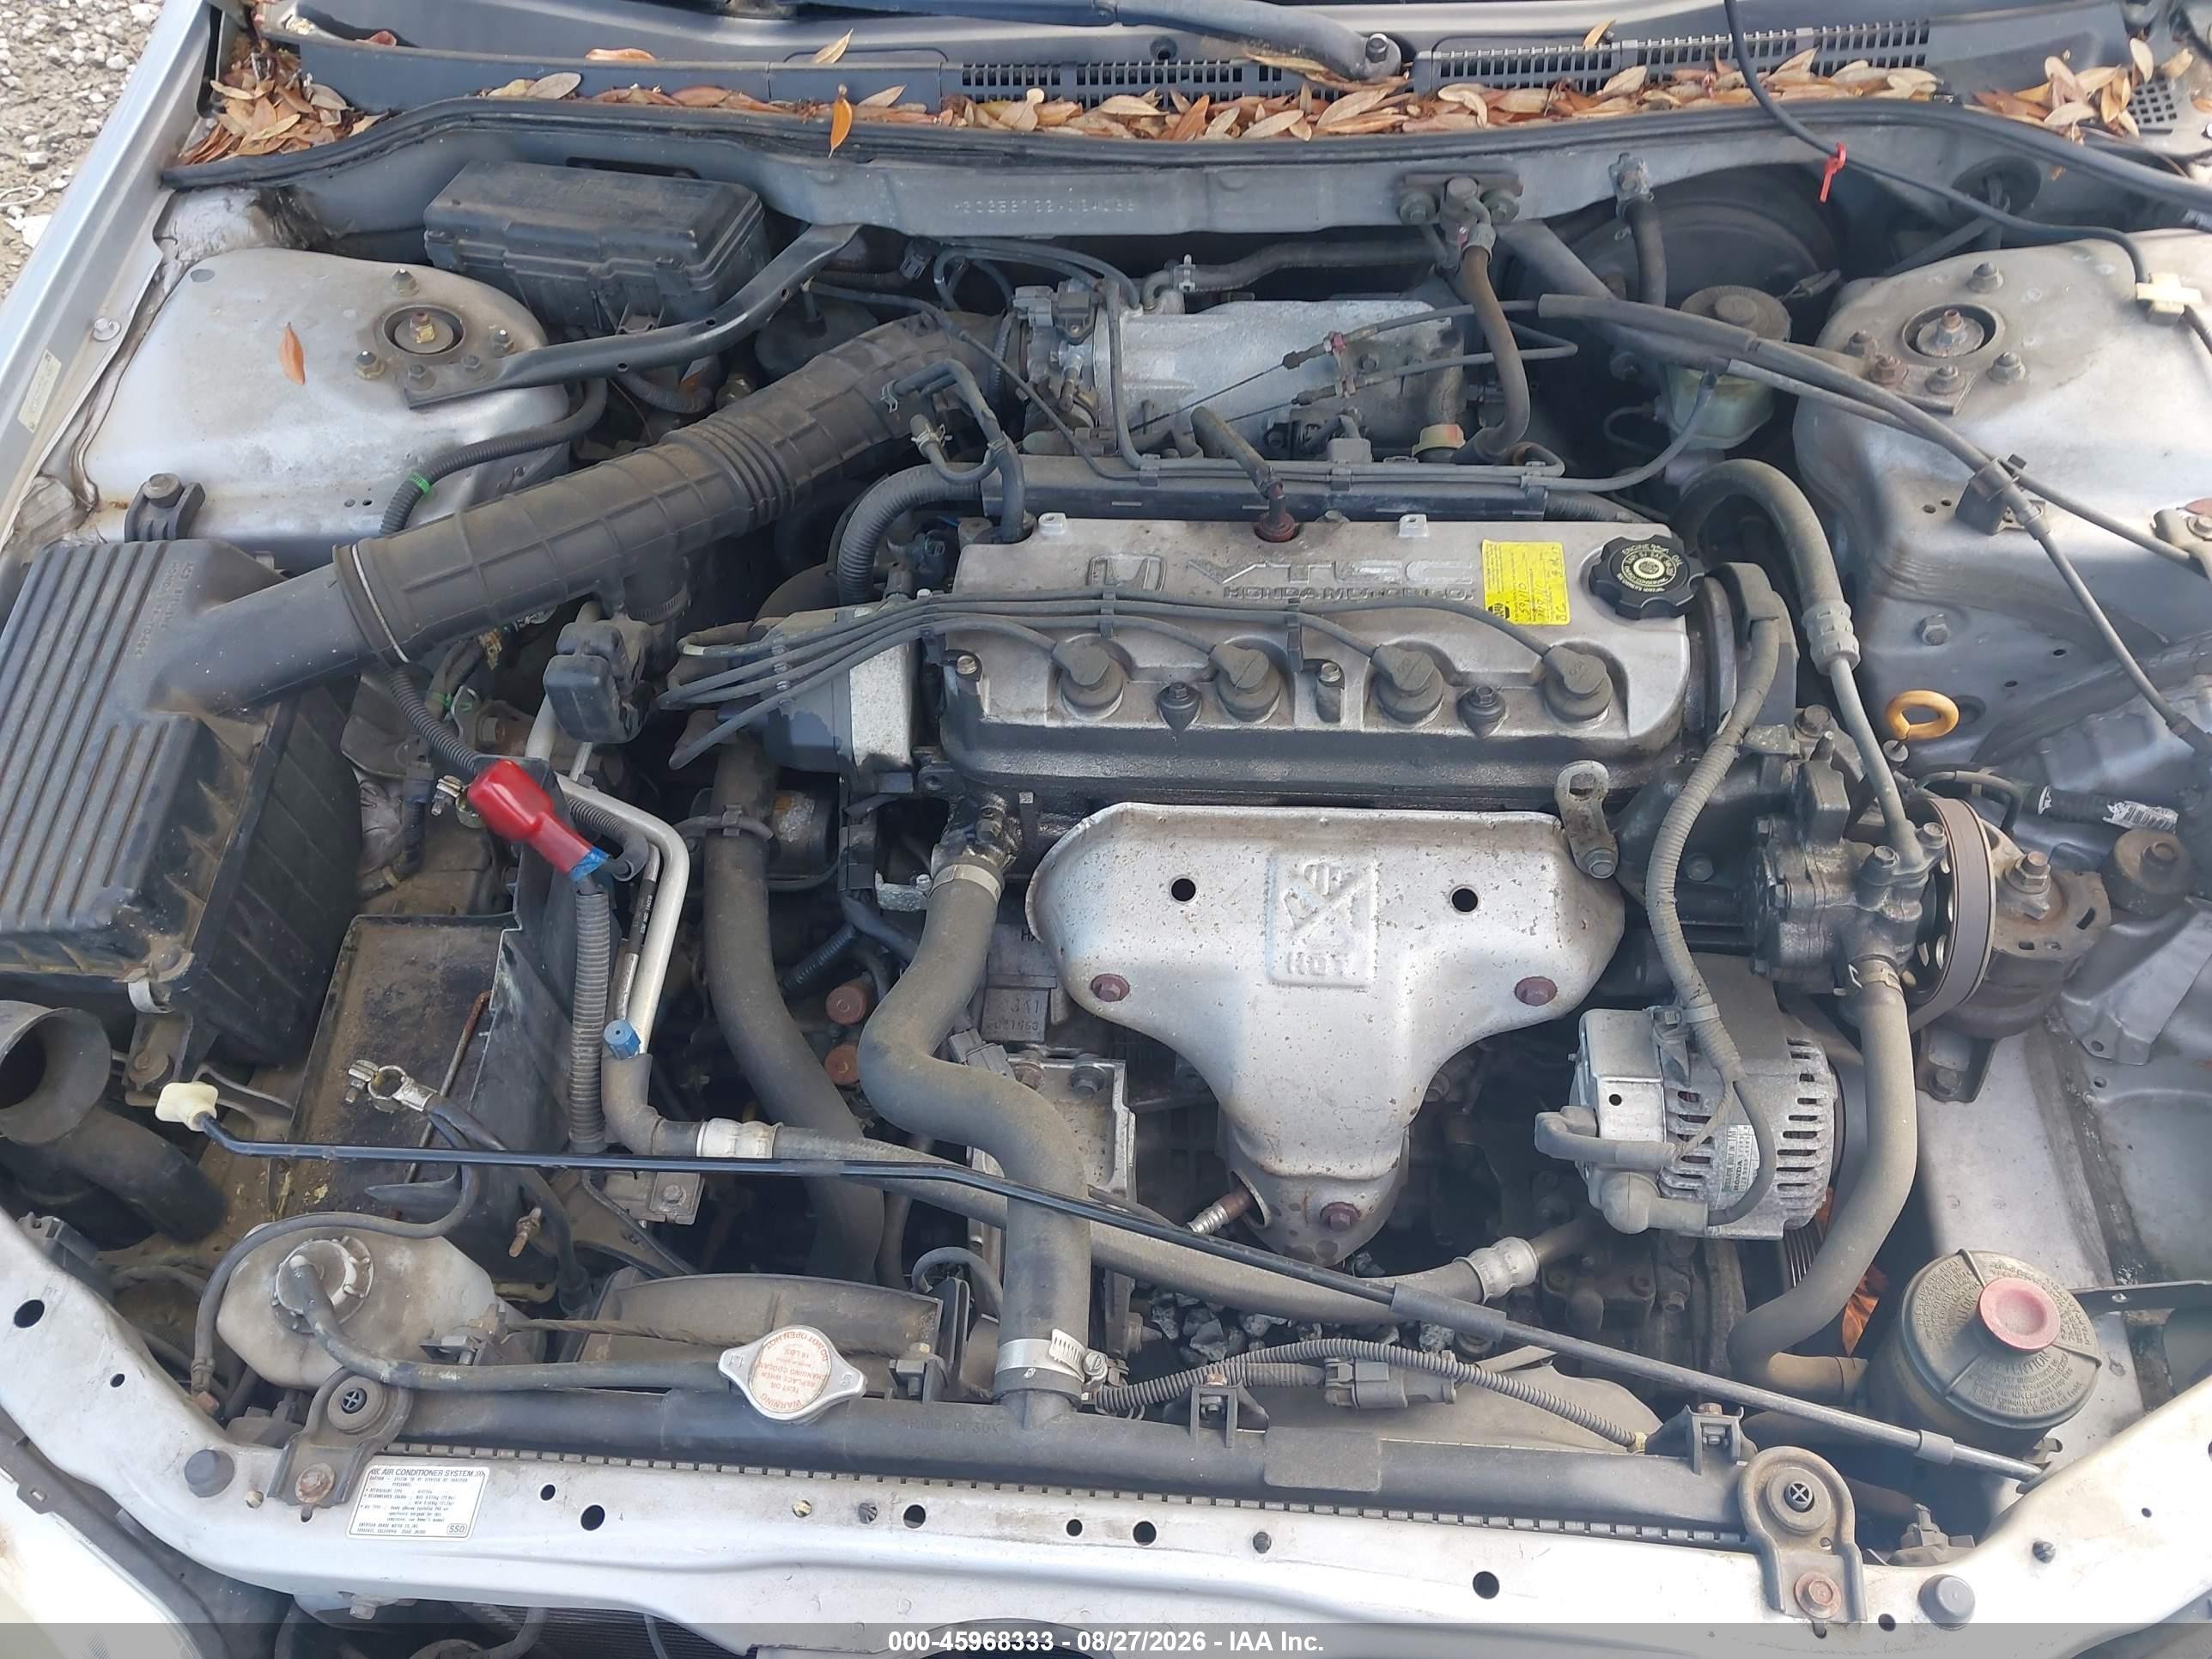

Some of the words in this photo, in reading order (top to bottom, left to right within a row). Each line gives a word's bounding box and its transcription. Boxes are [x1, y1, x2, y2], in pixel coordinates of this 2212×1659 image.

[1188, 560, 1474, 585] VTEC
[1223, 586, 1320, 599] HONDA
[760, 1392, 802, 1411] WARNING
